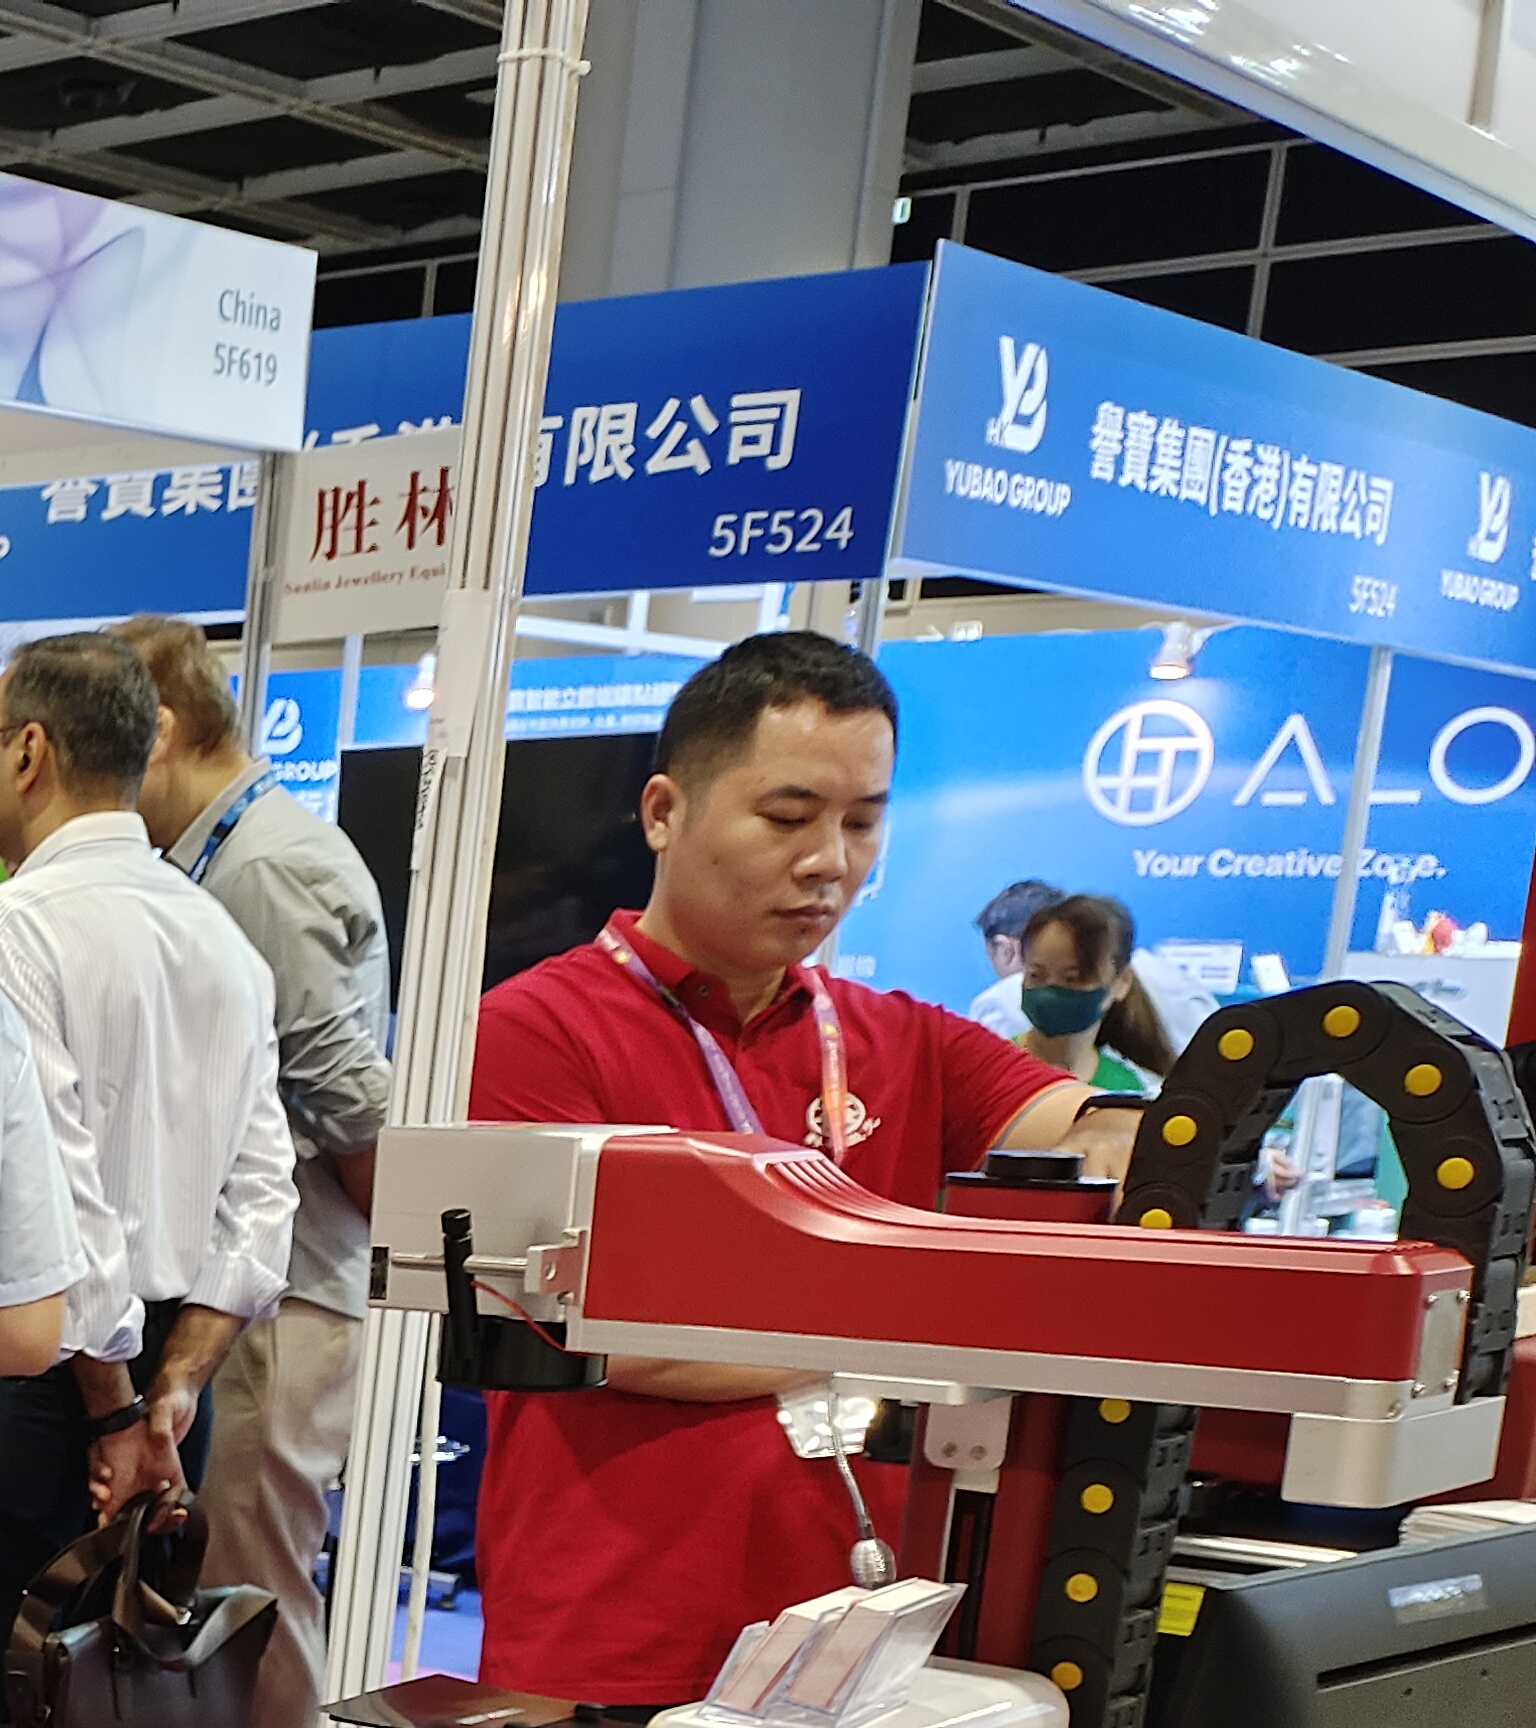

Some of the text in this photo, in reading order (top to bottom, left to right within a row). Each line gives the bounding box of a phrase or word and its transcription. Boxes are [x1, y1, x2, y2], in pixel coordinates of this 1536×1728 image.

[217, 289, 281, 331] China
[212, 343, 278, 386] 5F619
[944, 458, 1071, 517] YUBAO GROUP
[708, 506, 854, 557] 5F524
[1349, 574, 1398, 618] 5F524
[1133, 851, 1205, 879] Your
